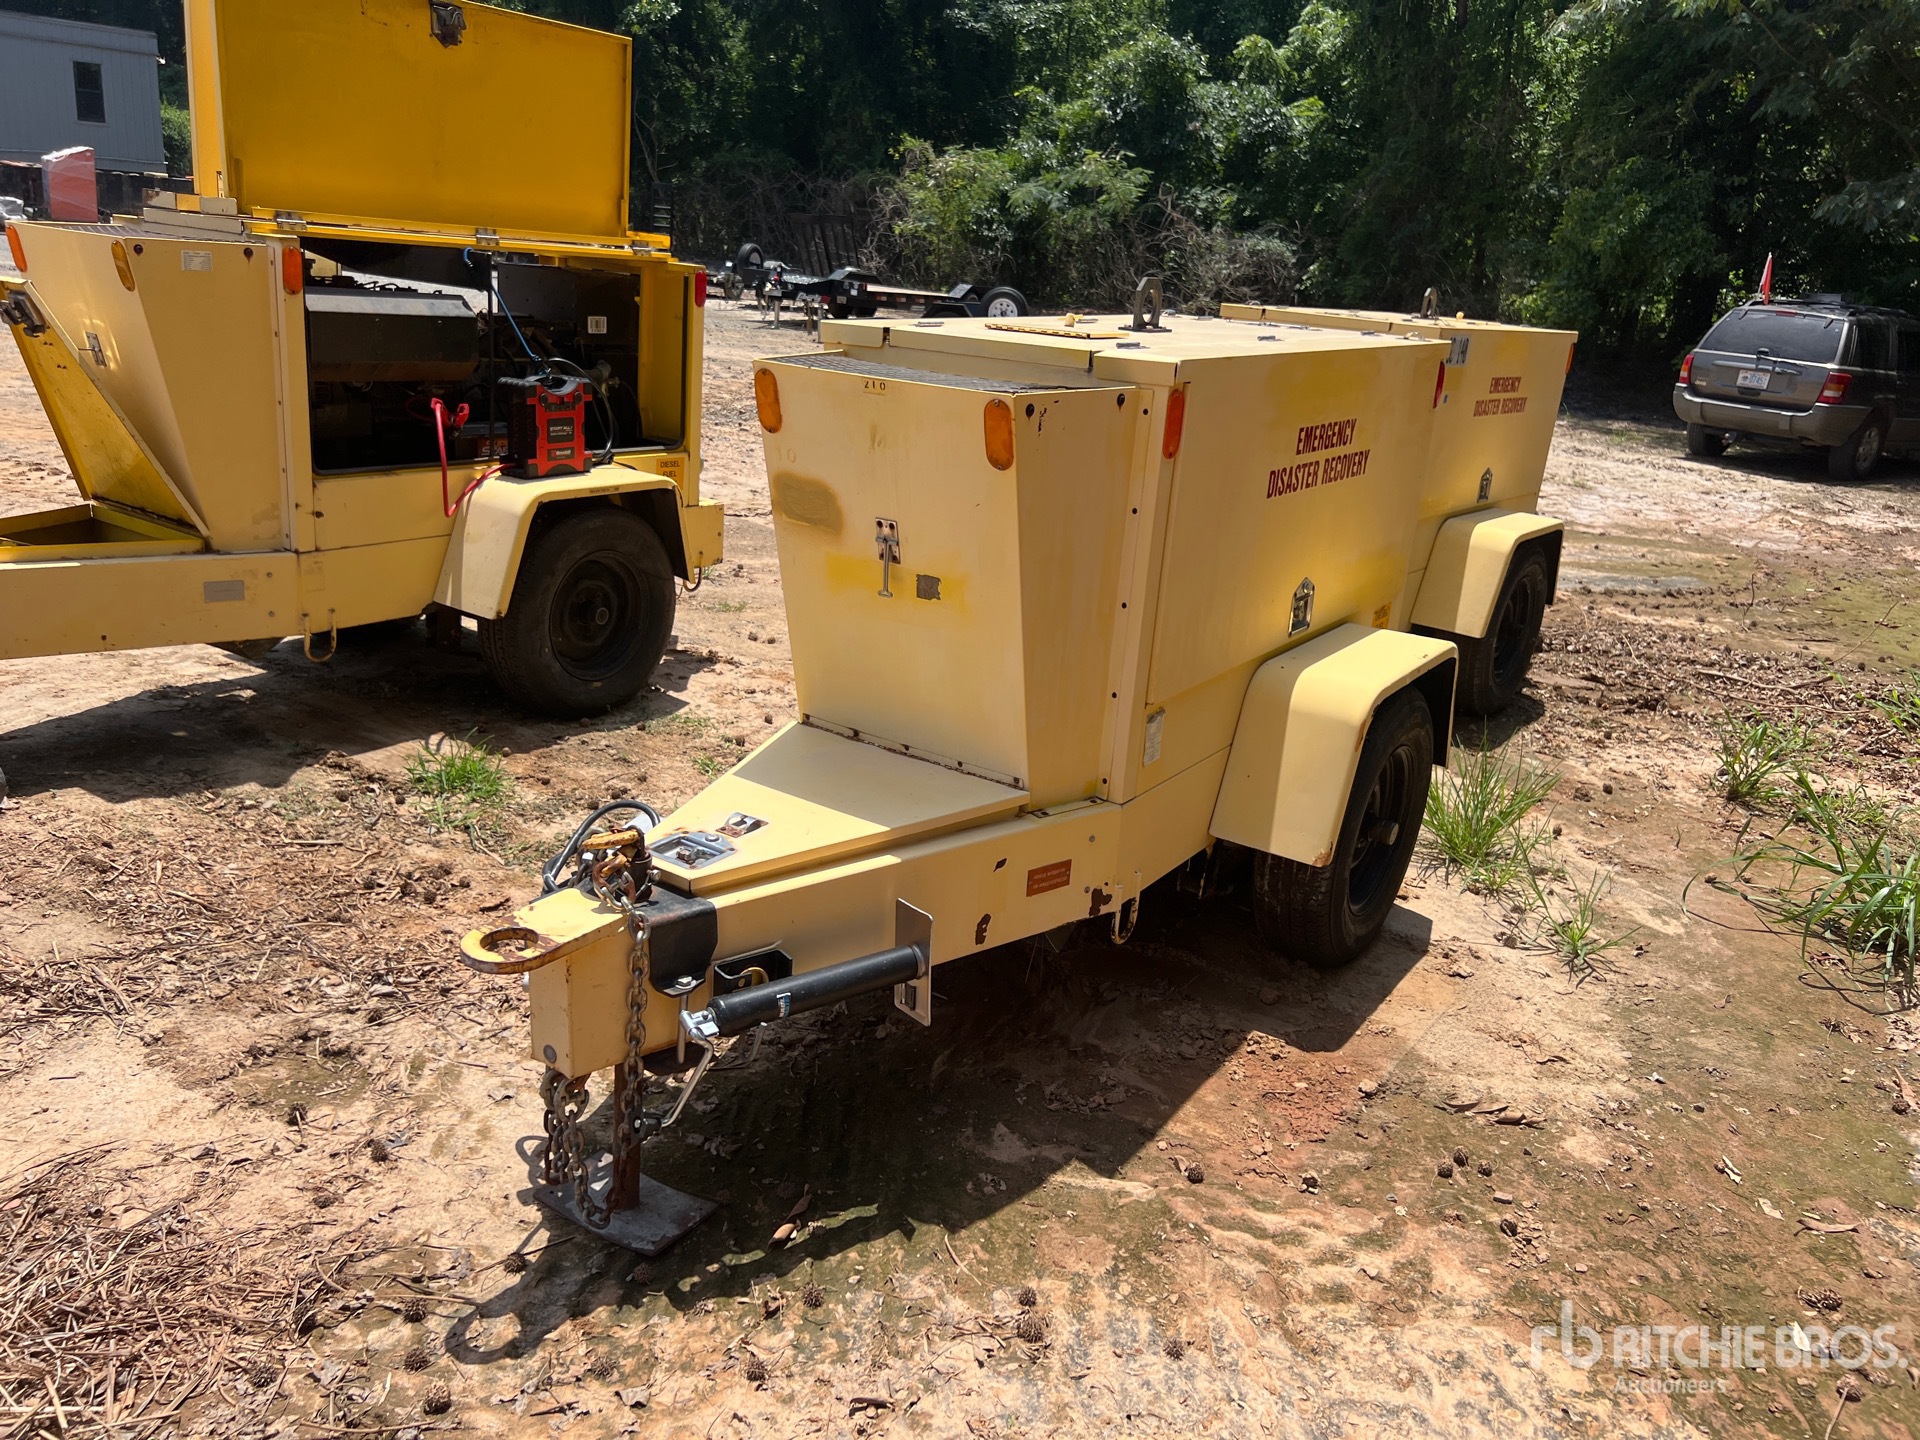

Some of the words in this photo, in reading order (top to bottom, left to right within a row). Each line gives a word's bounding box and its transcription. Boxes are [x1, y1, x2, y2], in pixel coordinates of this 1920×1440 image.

[1489, 376, 1522, 394] EMERGENCY
[1473, 399, 1501, 417] DISASTER
[1500, 397, 1528, 414] RECOVERY
[1295, 418, 1358, 456] EMERGENCY
[660, 460, 681, 468] DIESEL
[1266, 461, 1320, 500] DISASTER
[1321, 449, 1371, 485] RECOVERY
